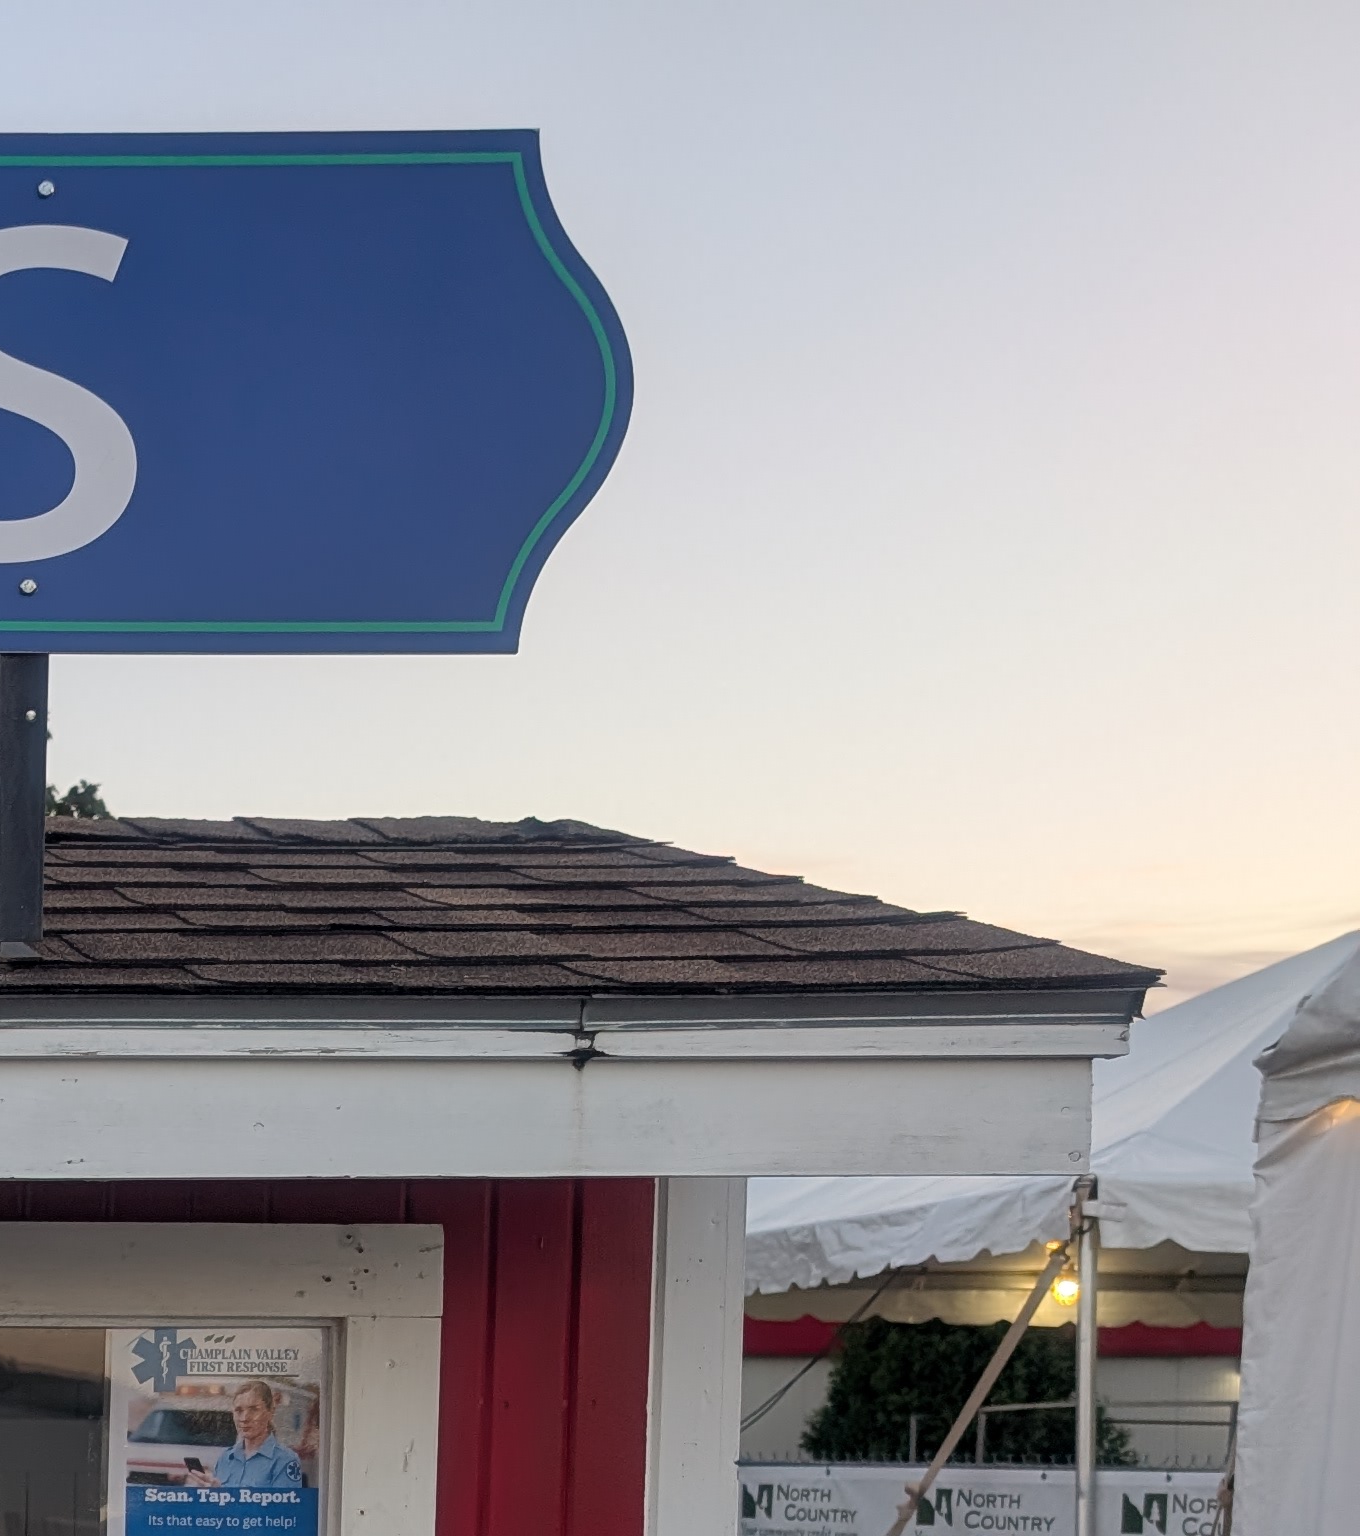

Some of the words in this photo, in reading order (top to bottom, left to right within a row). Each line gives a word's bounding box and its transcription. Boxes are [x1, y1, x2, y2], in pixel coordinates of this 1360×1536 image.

[180, 1348, 251, 1360] CHAMPLAIN
[255, 1348, 299, 1360] VALLEY
[189, 1361, 223, 1373] FIRST
[227, 1361, 288, 1373] RESPONSE
[144, 1488, 193, 1502] Scan.
[197, 1488, 236, 1506] Tap.
[239, 1489, 301, 1506] Report.
[777, 1484, 831, 1503] NORTH
[956, 1489, 1021, 1509] NORTH
[148, 1515, 164, 1526] Its
[166, 1515, 192, 1526] that
[195, 1518, 224, 1530] easy
[226, 1517, 240, 1527] to
[242, 1517, 263, 1530] get
[265, 1516, 297, 1530] help!
[784, 1504, 858, 1524] COUNTRY
[964, 1510, 1055, 1532] COUNTRY
